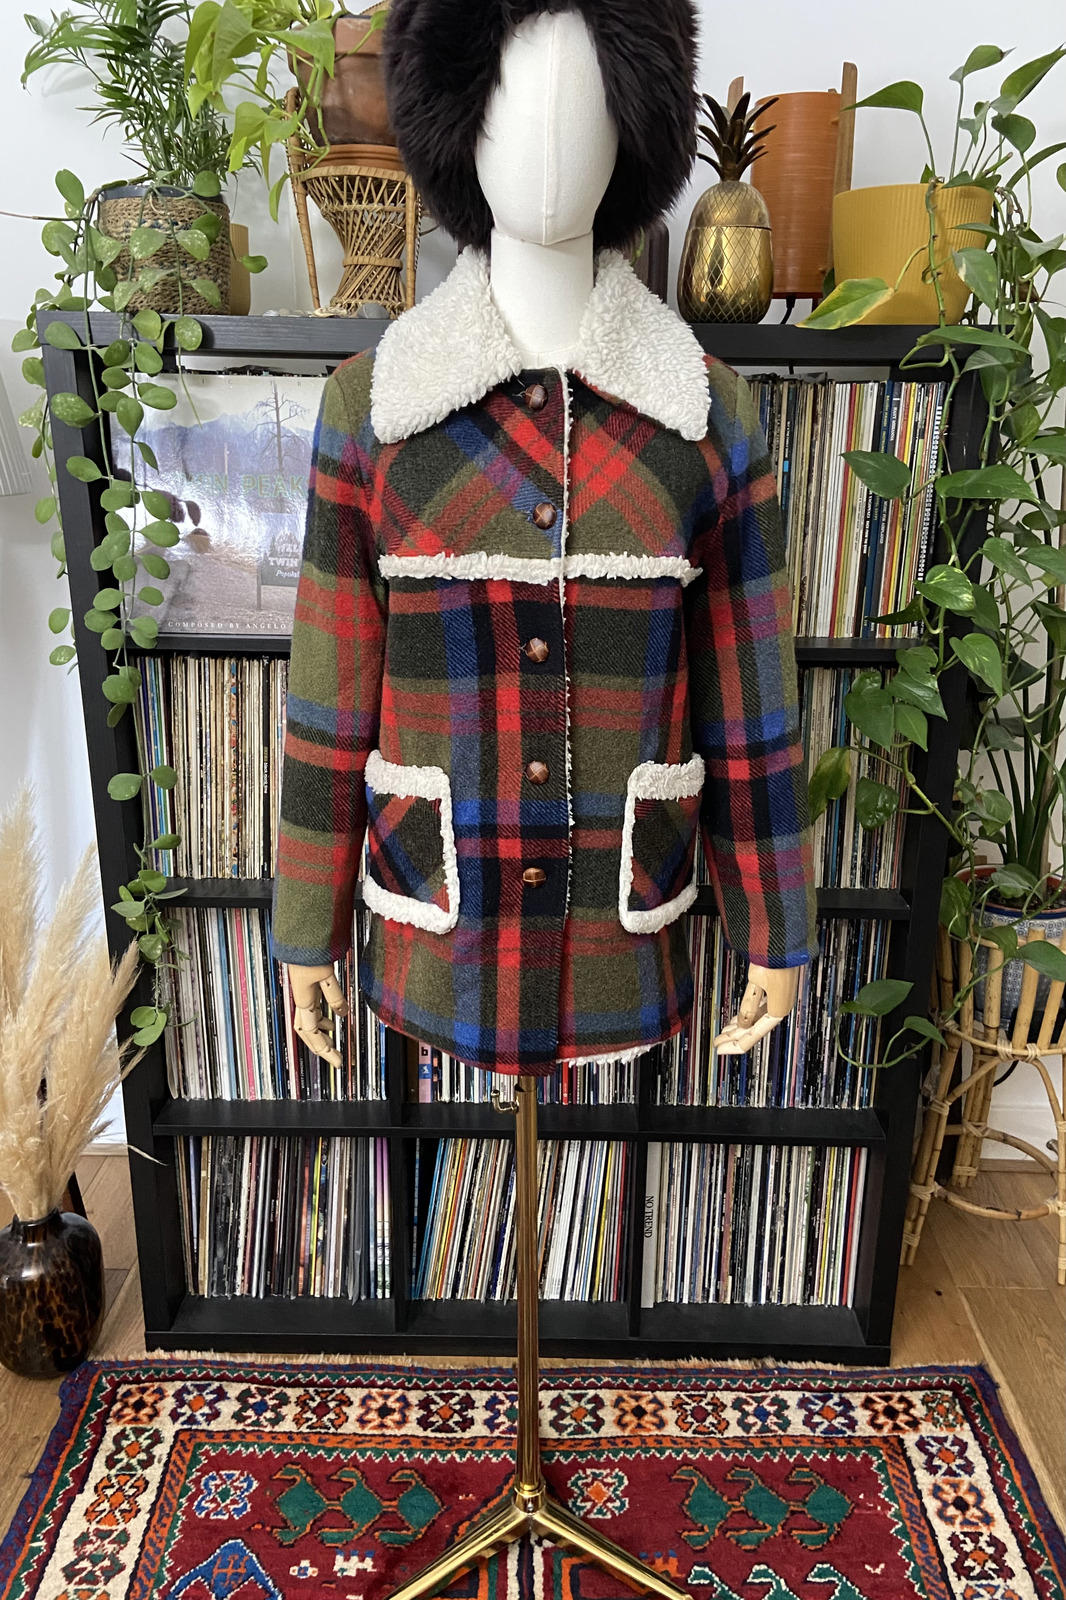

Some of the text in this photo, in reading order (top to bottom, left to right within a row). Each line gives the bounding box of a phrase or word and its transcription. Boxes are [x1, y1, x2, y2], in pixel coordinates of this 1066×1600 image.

[241, 473, 309, 499] PEAK
[268, 557, 299, 568] TWIN
[167, 621, 223, 629] COMPOSED
[644, 1195, 654, 1238] NO TREND
